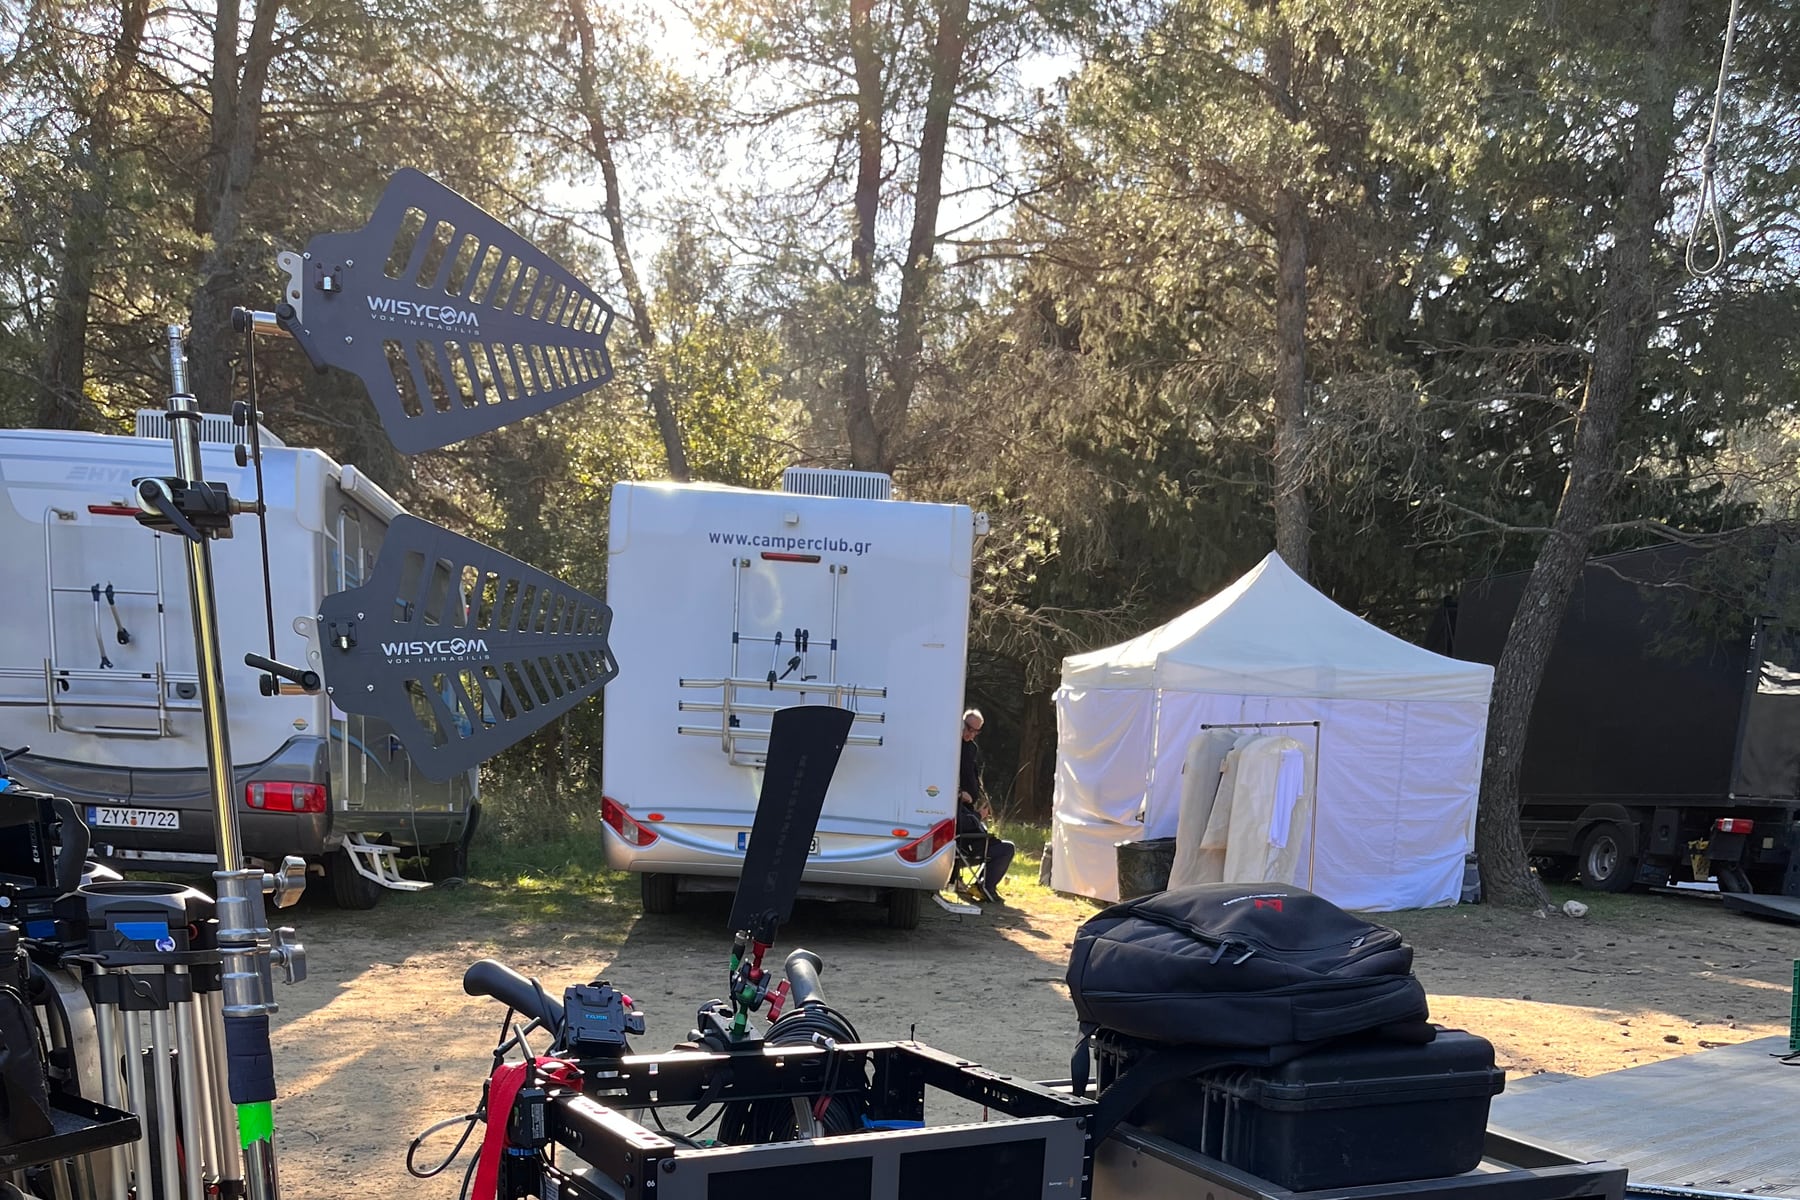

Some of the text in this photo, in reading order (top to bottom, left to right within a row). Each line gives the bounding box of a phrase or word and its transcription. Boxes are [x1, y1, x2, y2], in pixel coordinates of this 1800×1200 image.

[367, 295, 479, 327] WISYCOM
[371, 313, 395, 322] VOX
[708, 532, 872, 556] www.camperclub.gr
[381, 638, 488, 656] WISYCOM
[102, 809, 176, 827] ZYX 7722
